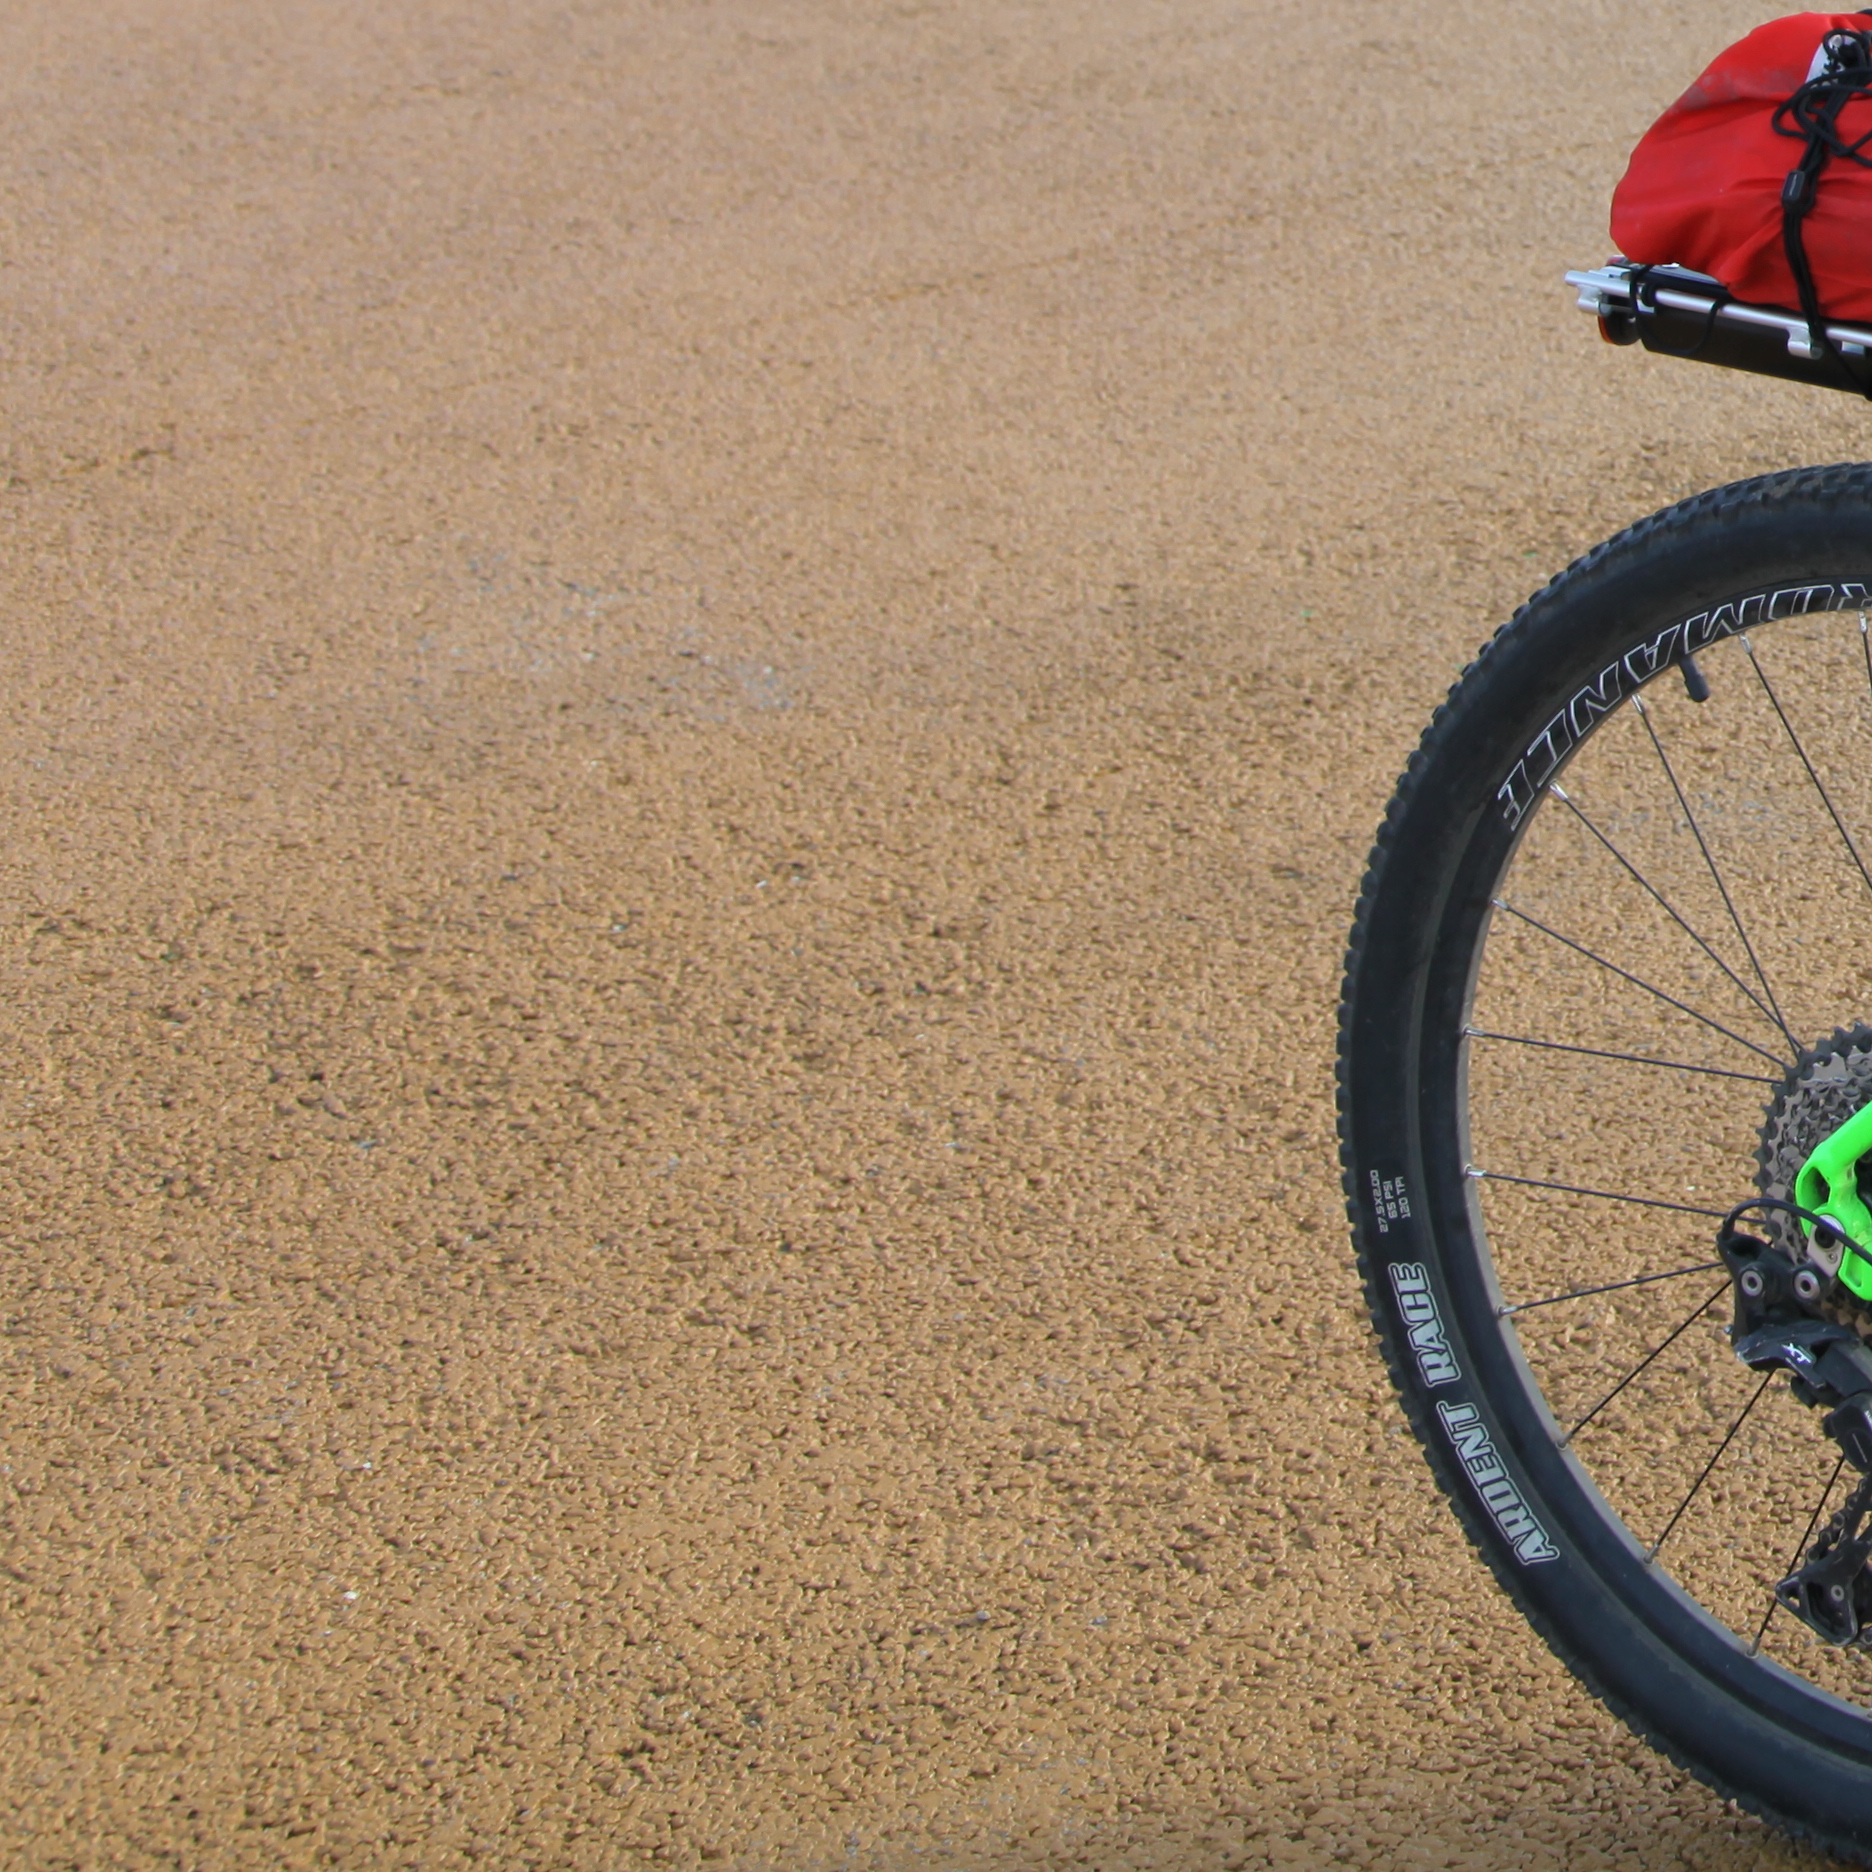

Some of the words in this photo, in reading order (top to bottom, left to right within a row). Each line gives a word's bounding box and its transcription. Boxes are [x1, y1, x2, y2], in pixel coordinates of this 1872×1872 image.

[1382, 1180, 1394, 1200] PSI
[1388, 1262, 1462, 1388] RACE
[1437, 1400, 1560, 1566] ARDENT
